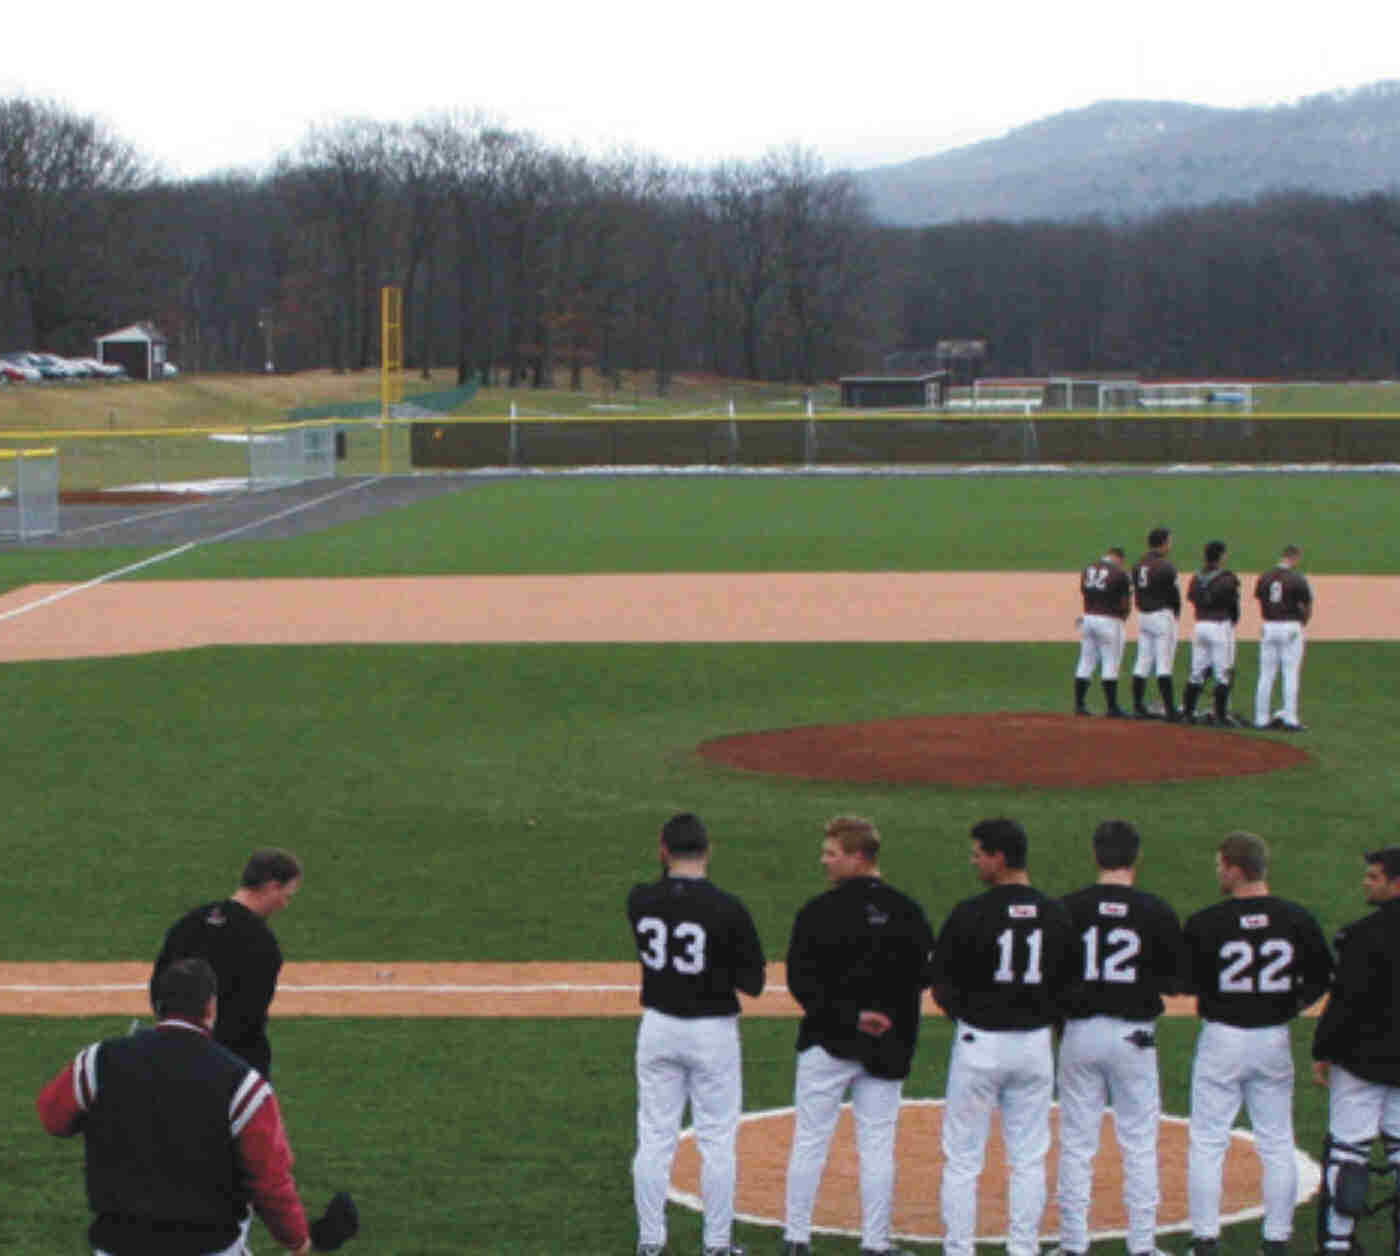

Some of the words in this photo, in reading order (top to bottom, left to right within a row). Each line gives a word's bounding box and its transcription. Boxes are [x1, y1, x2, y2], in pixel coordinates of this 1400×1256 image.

[636, 916, 707, 976] 33
[994, 928, 1043, 984] 11
[1082, 925, 1141, 983] 12
[1219, 938, 1294, 993] 22
